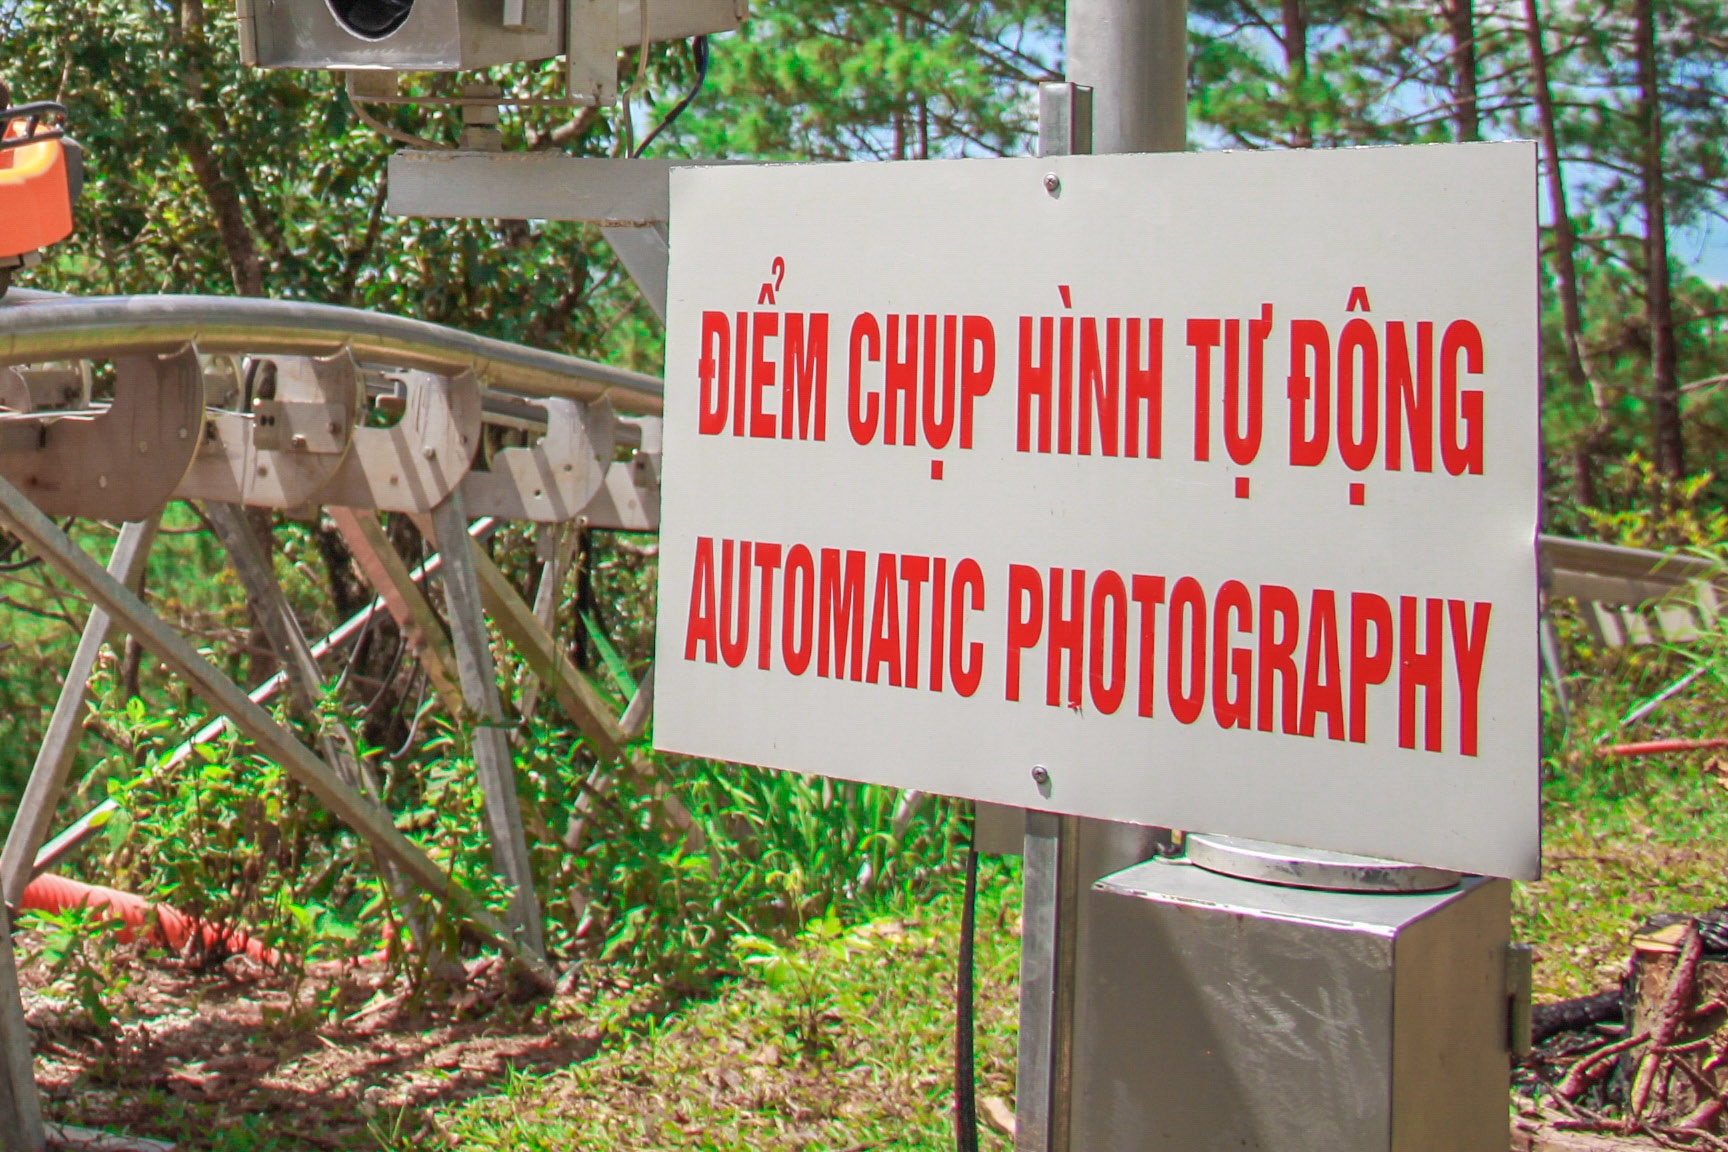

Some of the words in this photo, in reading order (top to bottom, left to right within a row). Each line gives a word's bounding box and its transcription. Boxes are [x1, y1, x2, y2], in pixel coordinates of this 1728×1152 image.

[697, 255, 829, 442] ĐIỂM
[847, 311, 996, 481] CHỤP
[1016, 284, 1164, 459] HÌNH
[1186, 302, 1273, 499] TỰ
[1287, 286, 1485, 506] ĐỘNG
[685, 536, 985, 698] AUTOMATIC
[1005, 563, 1492, 757] PHOTOGRAPHY
